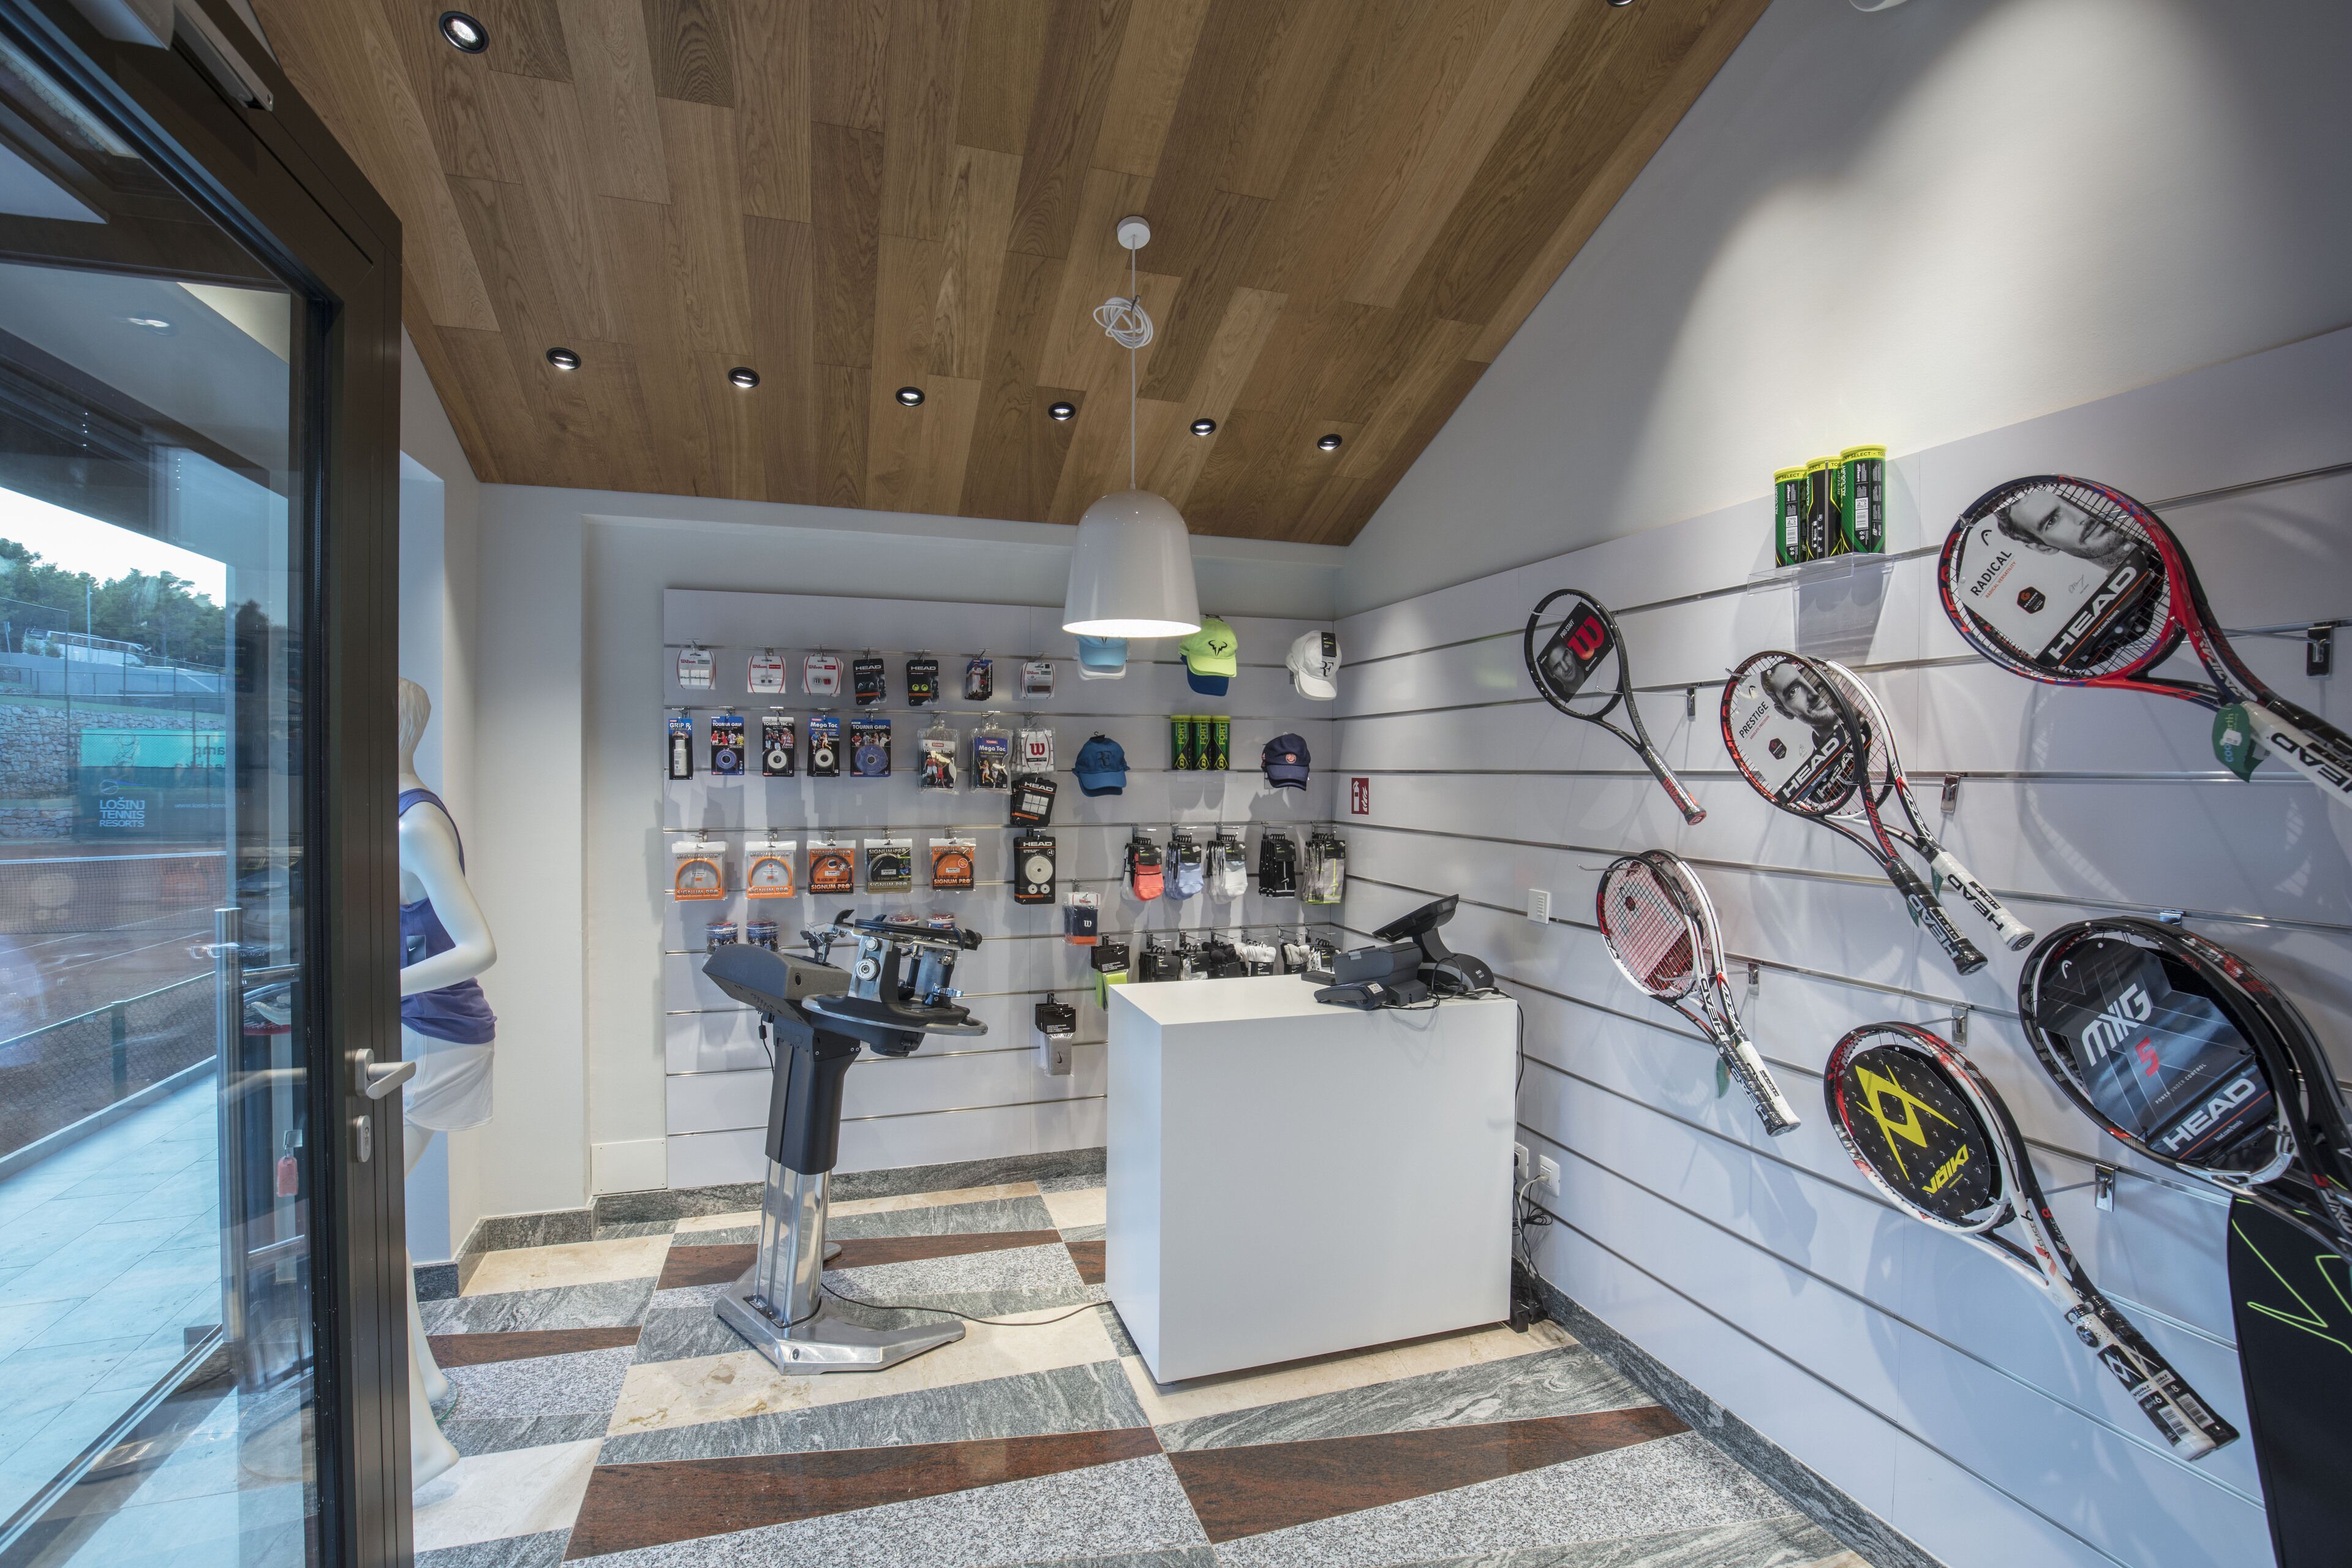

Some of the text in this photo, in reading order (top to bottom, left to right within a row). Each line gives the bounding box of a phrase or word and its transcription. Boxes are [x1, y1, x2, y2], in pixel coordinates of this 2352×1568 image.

[1970, 551, 2012, 596] RADICAL
[1985, 561, 2016, 598] RADICAL VERSATILITY
[1565, 619, 1575, 631] STAFF
[2048, 567, 2137, 659] HEAD
[2092, 609, 2119, 638] head.com/tennis
[1739, 701, 1769, 738] PRESTIGE
[1750, 715, 1770, 740] ABSOLUTE PRECISION
[1782, 737, 1839, 798] HEAD
[2224, 741, 2234, 763] coo
[99, 797, 145, 809] LOŠINJ
[1024, 782, 1054, 792] HEAD
[1663, 777, 1686, 812] Wilson
[99, 810, 145, 819] TENNIS
[1866, 799, 1899, 858] PRESTIGE
[1902, 787, 1940, 845] SPEED
[1947, 873, 2004, 931] HEAD
[1908, 894, 1959, 959] HEAD
[1701, 978, 1725, 1035] HEAD
[2082, 983, 2154, 1067] MXG
[2135, 1037, 2160, 1077] 5
[1731, 1068, 1769, 1121] HEAD
[2155, 1063, 2207, 1104] POWER UNDER CONTROL
[2162, 1078, 2256, 1152] HEAD
[2214, 1120, 2244, 1142] head.com/tennis
[2155, 1395, 2163, 1404] 6
